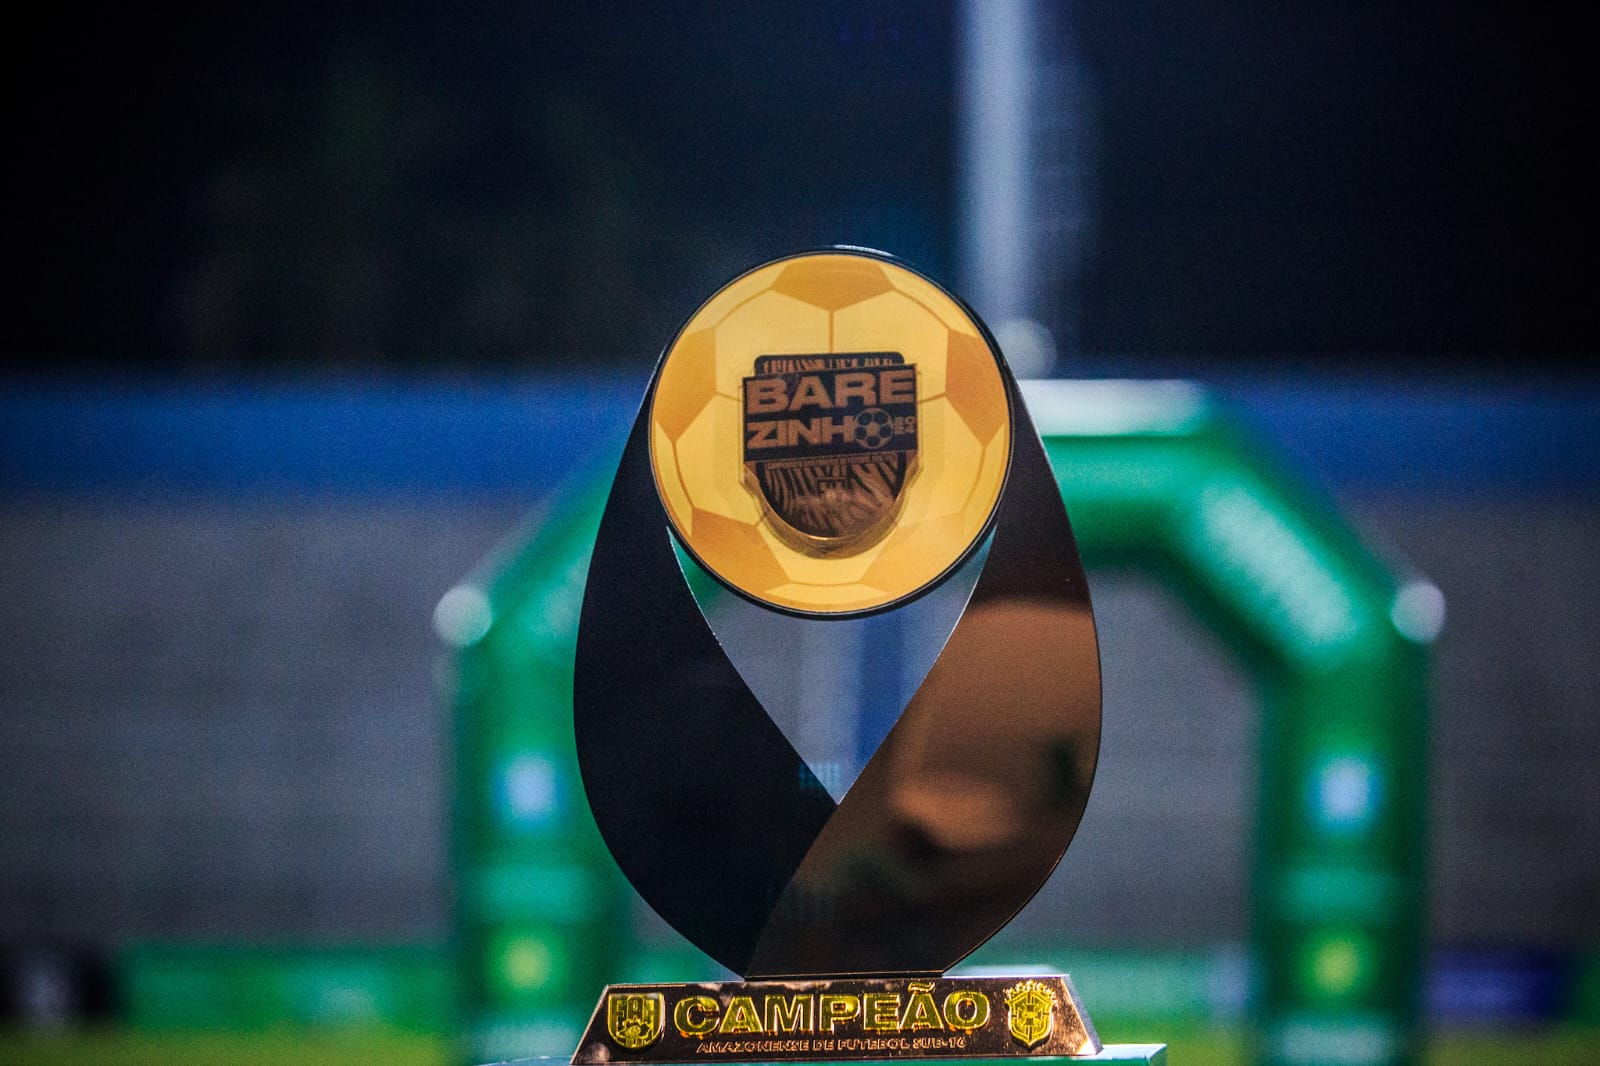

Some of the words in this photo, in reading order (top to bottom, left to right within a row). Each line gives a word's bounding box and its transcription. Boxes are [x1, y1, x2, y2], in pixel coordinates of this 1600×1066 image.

[746, 369, 914, 415] BARE
[674, 982, 990, 1035] CAMPEÃO
[695, 1039, 810, 1054] AMAZONENSE
[812, 1039, 834, 1051] DE
[837, 1038, 910, 1051] FUTEBOL
